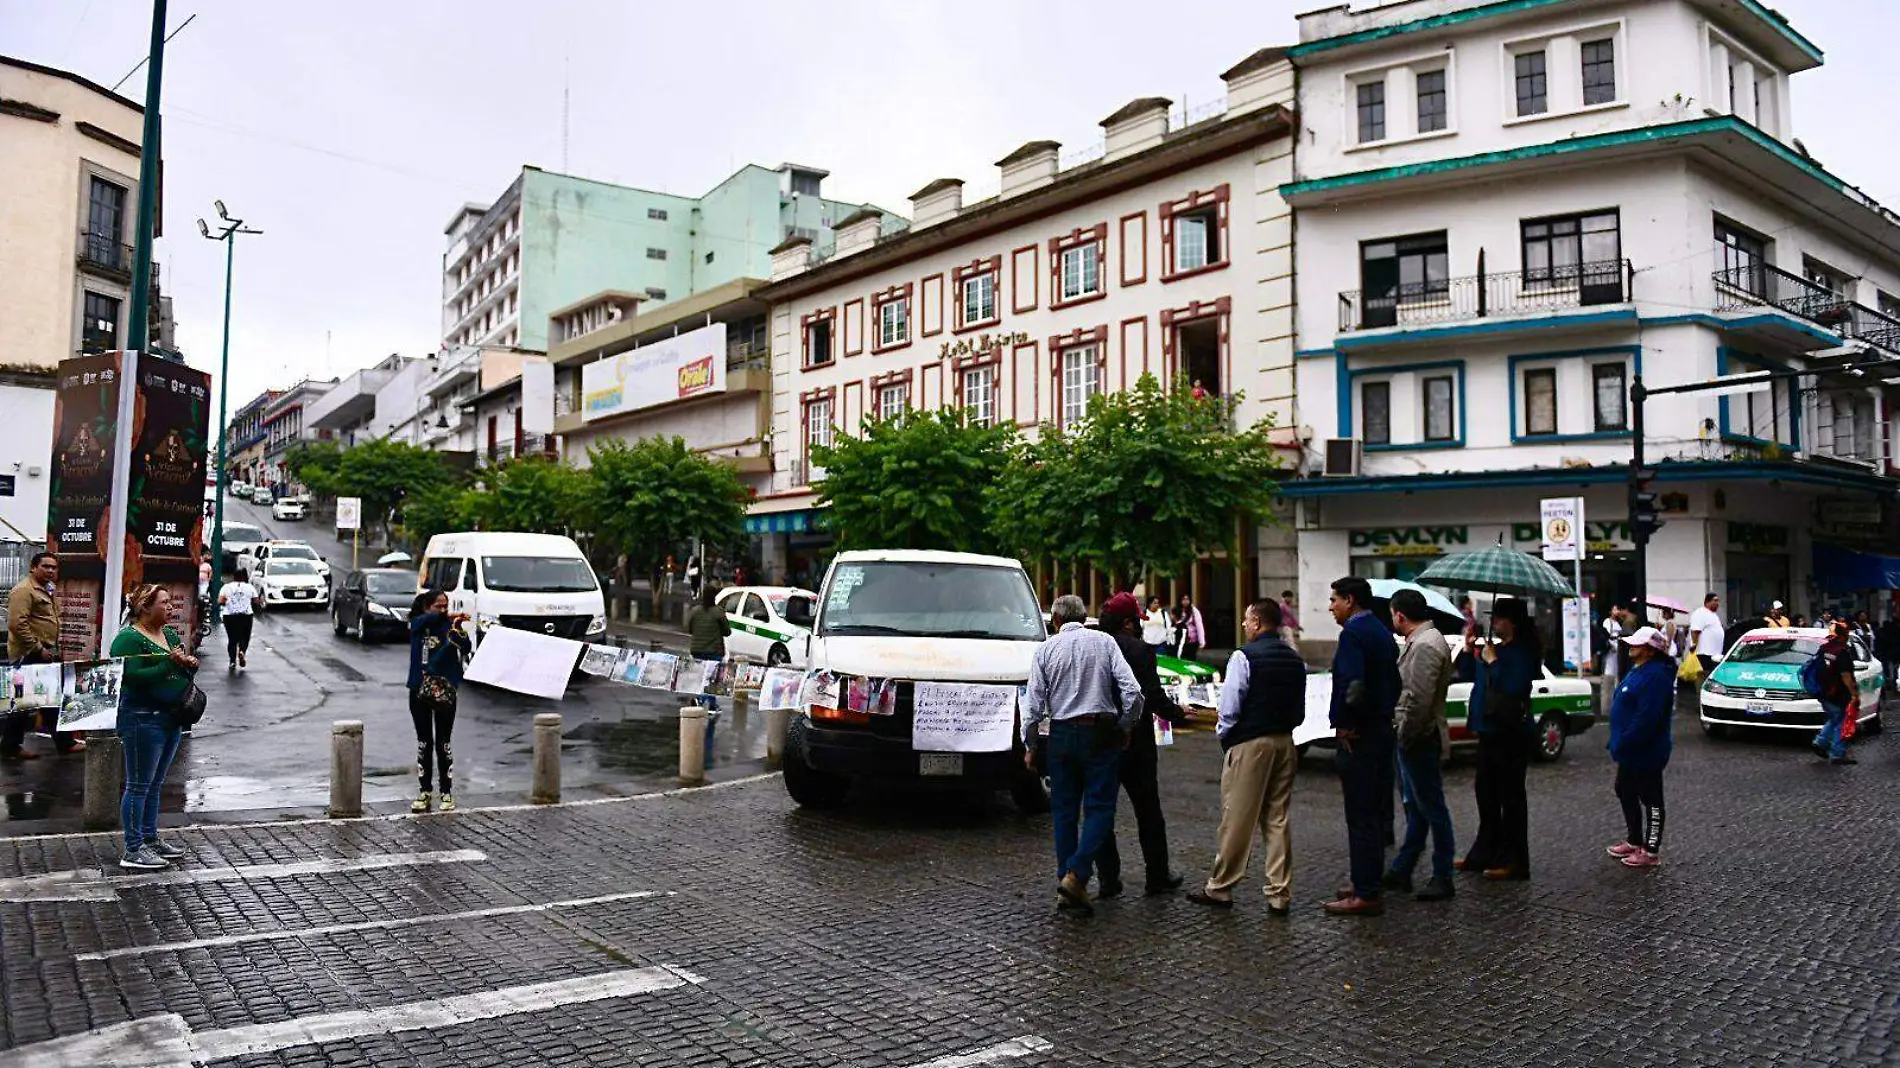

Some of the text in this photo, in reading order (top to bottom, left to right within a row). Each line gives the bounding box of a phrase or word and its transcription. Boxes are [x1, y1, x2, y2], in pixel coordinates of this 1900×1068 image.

[76, 518, 87, 528] DE
[155, 521, 177, 532] 31 DE
[61, 532, 93, 542] OCTUBRE
[147, 534, 185, 547] OCTUBRE
[1349, 524, 1468, 547] DEVLYN
